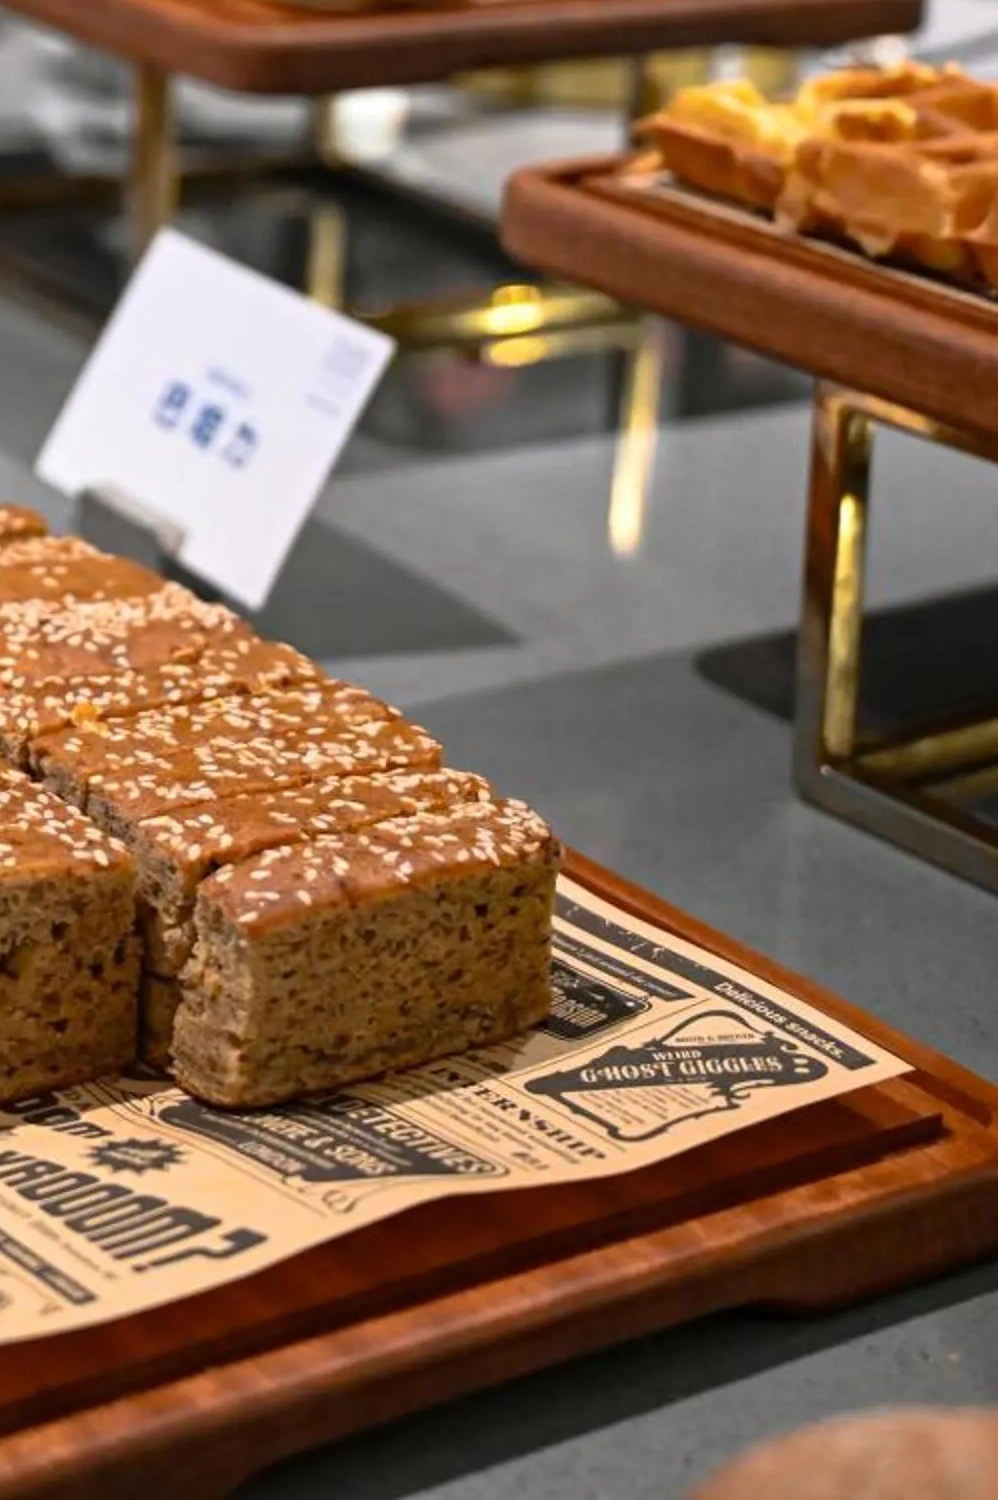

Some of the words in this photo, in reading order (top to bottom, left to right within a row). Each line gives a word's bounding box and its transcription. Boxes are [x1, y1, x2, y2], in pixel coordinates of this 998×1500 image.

[713, 979, 787, 1025] Delicious
[579, 1059, 675, 1083] GHOST
[678, 1056, 783, 1078] GIGGLES
[330, 1099, 497, 1174] DETECTIVES
